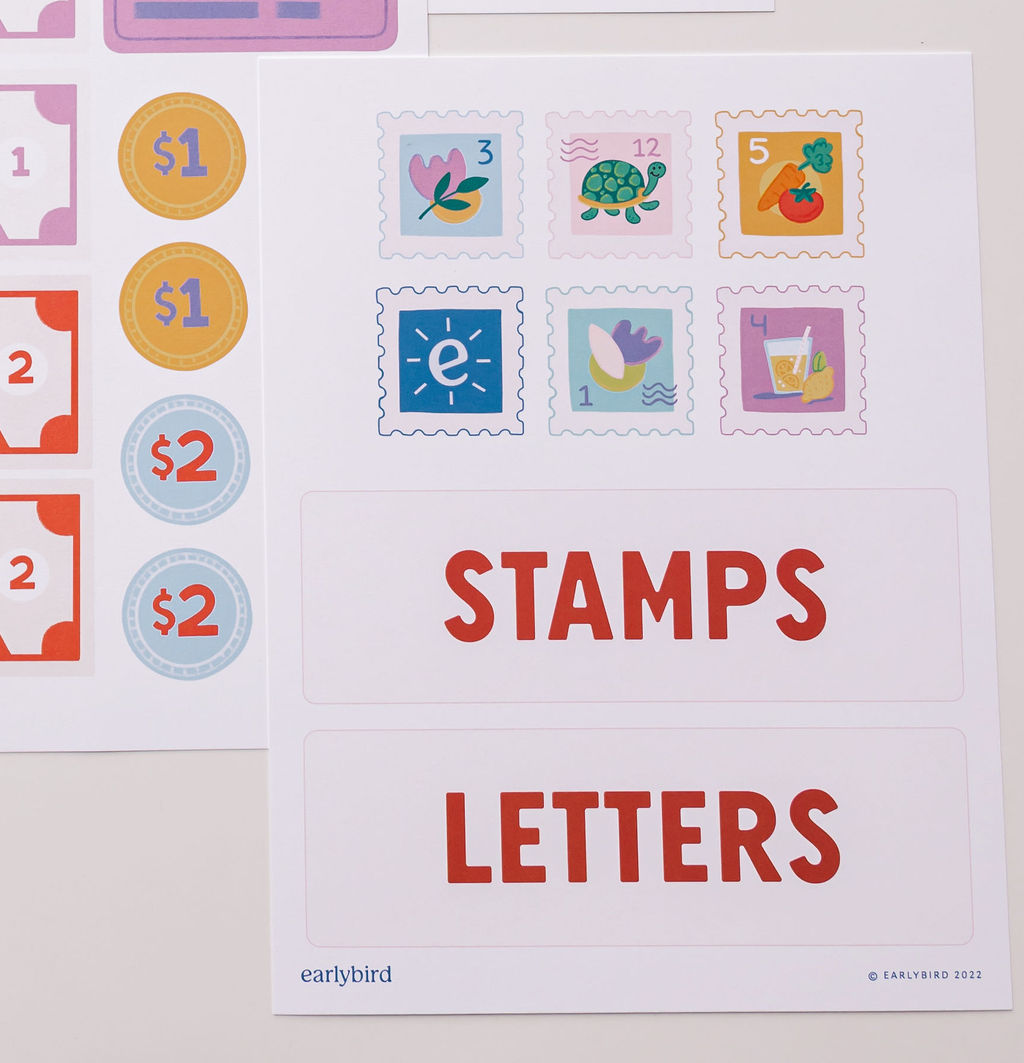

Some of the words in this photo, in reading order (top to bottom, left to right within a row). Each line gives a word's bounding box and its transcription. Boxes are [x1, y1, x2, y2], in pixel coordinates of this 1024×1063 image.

[11, 147, 30, 177] 1
[153, 128, 208, 178] $1
[477, 139, 494, 165] 3
[633, 138, 661, 158] 12
[749, 138, 769, 164] 5
[154, 278, 210, 328] $1
[749, 313, 768, 336] 4
[8, 350, 34, 384] 2
[428, 336, 469, 386] e
[579, 385, 593, 406] 1
[151, 429, 217, 482] $2
[10, 555, 36, 590] 2
[153, 584, 219, 637] $2
[444, 549, 826, 642] STAMPS
[446, 789, 840, 884] LETTERS
[301, 965, 392, 988] earlybird
[883, 970, 949, 980] EARLYBIRD
[954, 970, 982, 979] 2022
